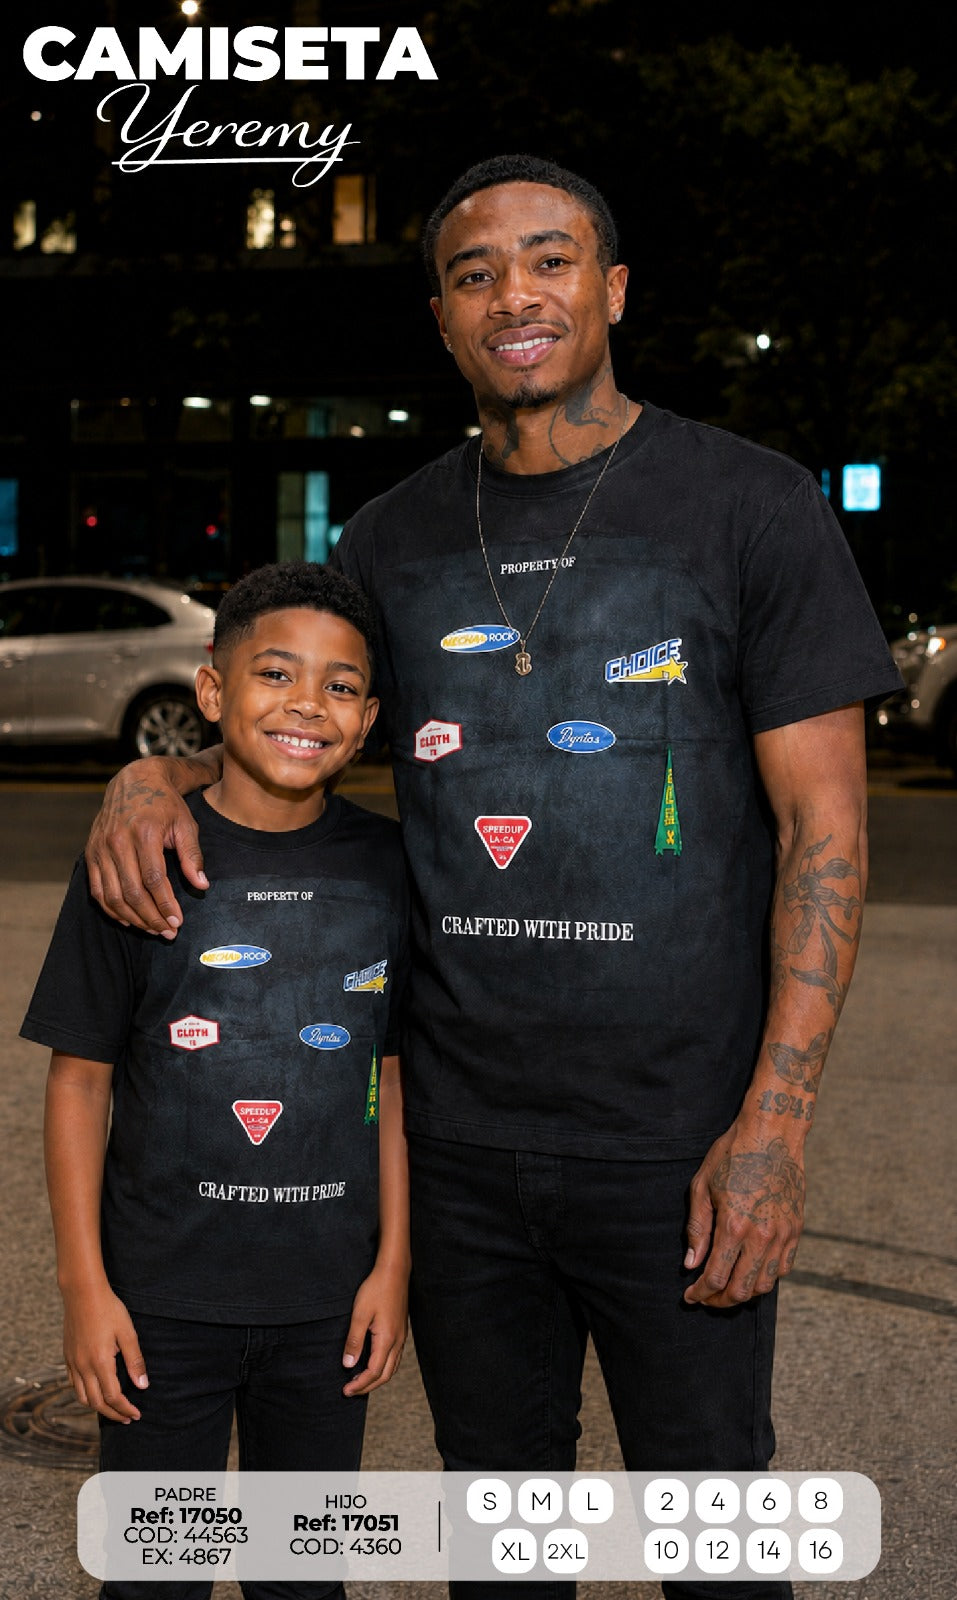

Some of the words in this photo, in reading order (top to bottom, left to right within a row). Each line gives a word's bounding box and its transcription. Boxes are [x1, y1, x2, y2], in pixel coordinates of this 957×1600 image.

[500, 558, 559, 575] PROPERTY
[561, 556, 576, 568] OF
[489, 632, 515, 642] ROCK
[605, 638, 682, 682] CHOICE
[420, 734, 450, 748] CLOTH
[483, 825, 524, 834] SPEEDUP
[248, 892, 298, 901] PROPERTY
[301, 892, 313, 900] OF
[443, 916, 519, 936] CRAFTED
[524, 920, 570, 939] WITH
[575, 922, 633, 940] PRIDE
[243, 952, 267, 961] ROCK
[177, 1028, 209, 1038] CLOTH
[760, 1089, 815, 1121] 1948
[199, 1182, 268, 1202] CRAFTED
[274, 1186, 309, 1202] WITH
[312, 1182, 345, 1200] PRIDE
